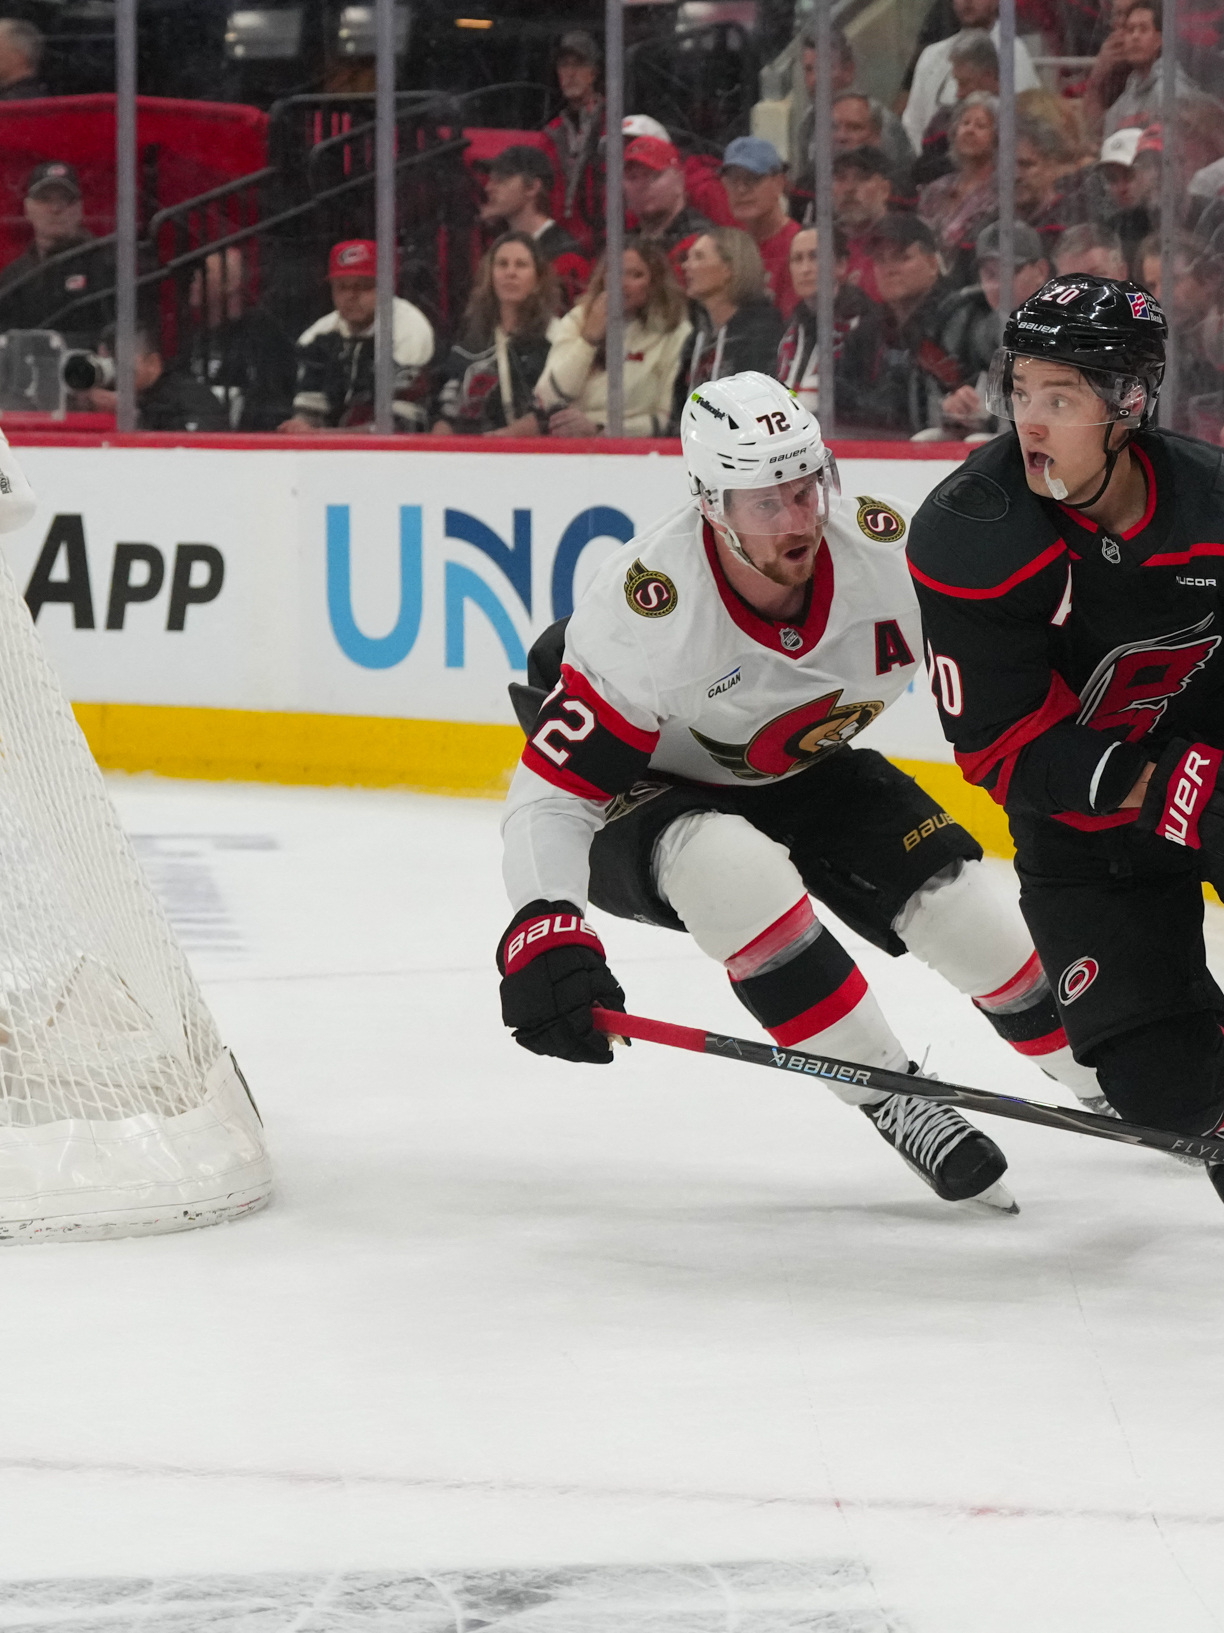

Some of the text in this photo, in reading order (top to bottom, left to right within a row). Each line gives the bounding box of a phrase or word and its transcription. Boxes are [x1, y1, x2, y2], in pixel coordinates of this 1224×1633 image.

[755, 411, 792, 436] 72
[769, 447, 808, 464] BAUER
[874, 619, 916, 677] A
[707, 671, 742, 699] CALIAN
[926, 637, 964, 717] 0
[787, 1055, 872, 1085] BAUER
